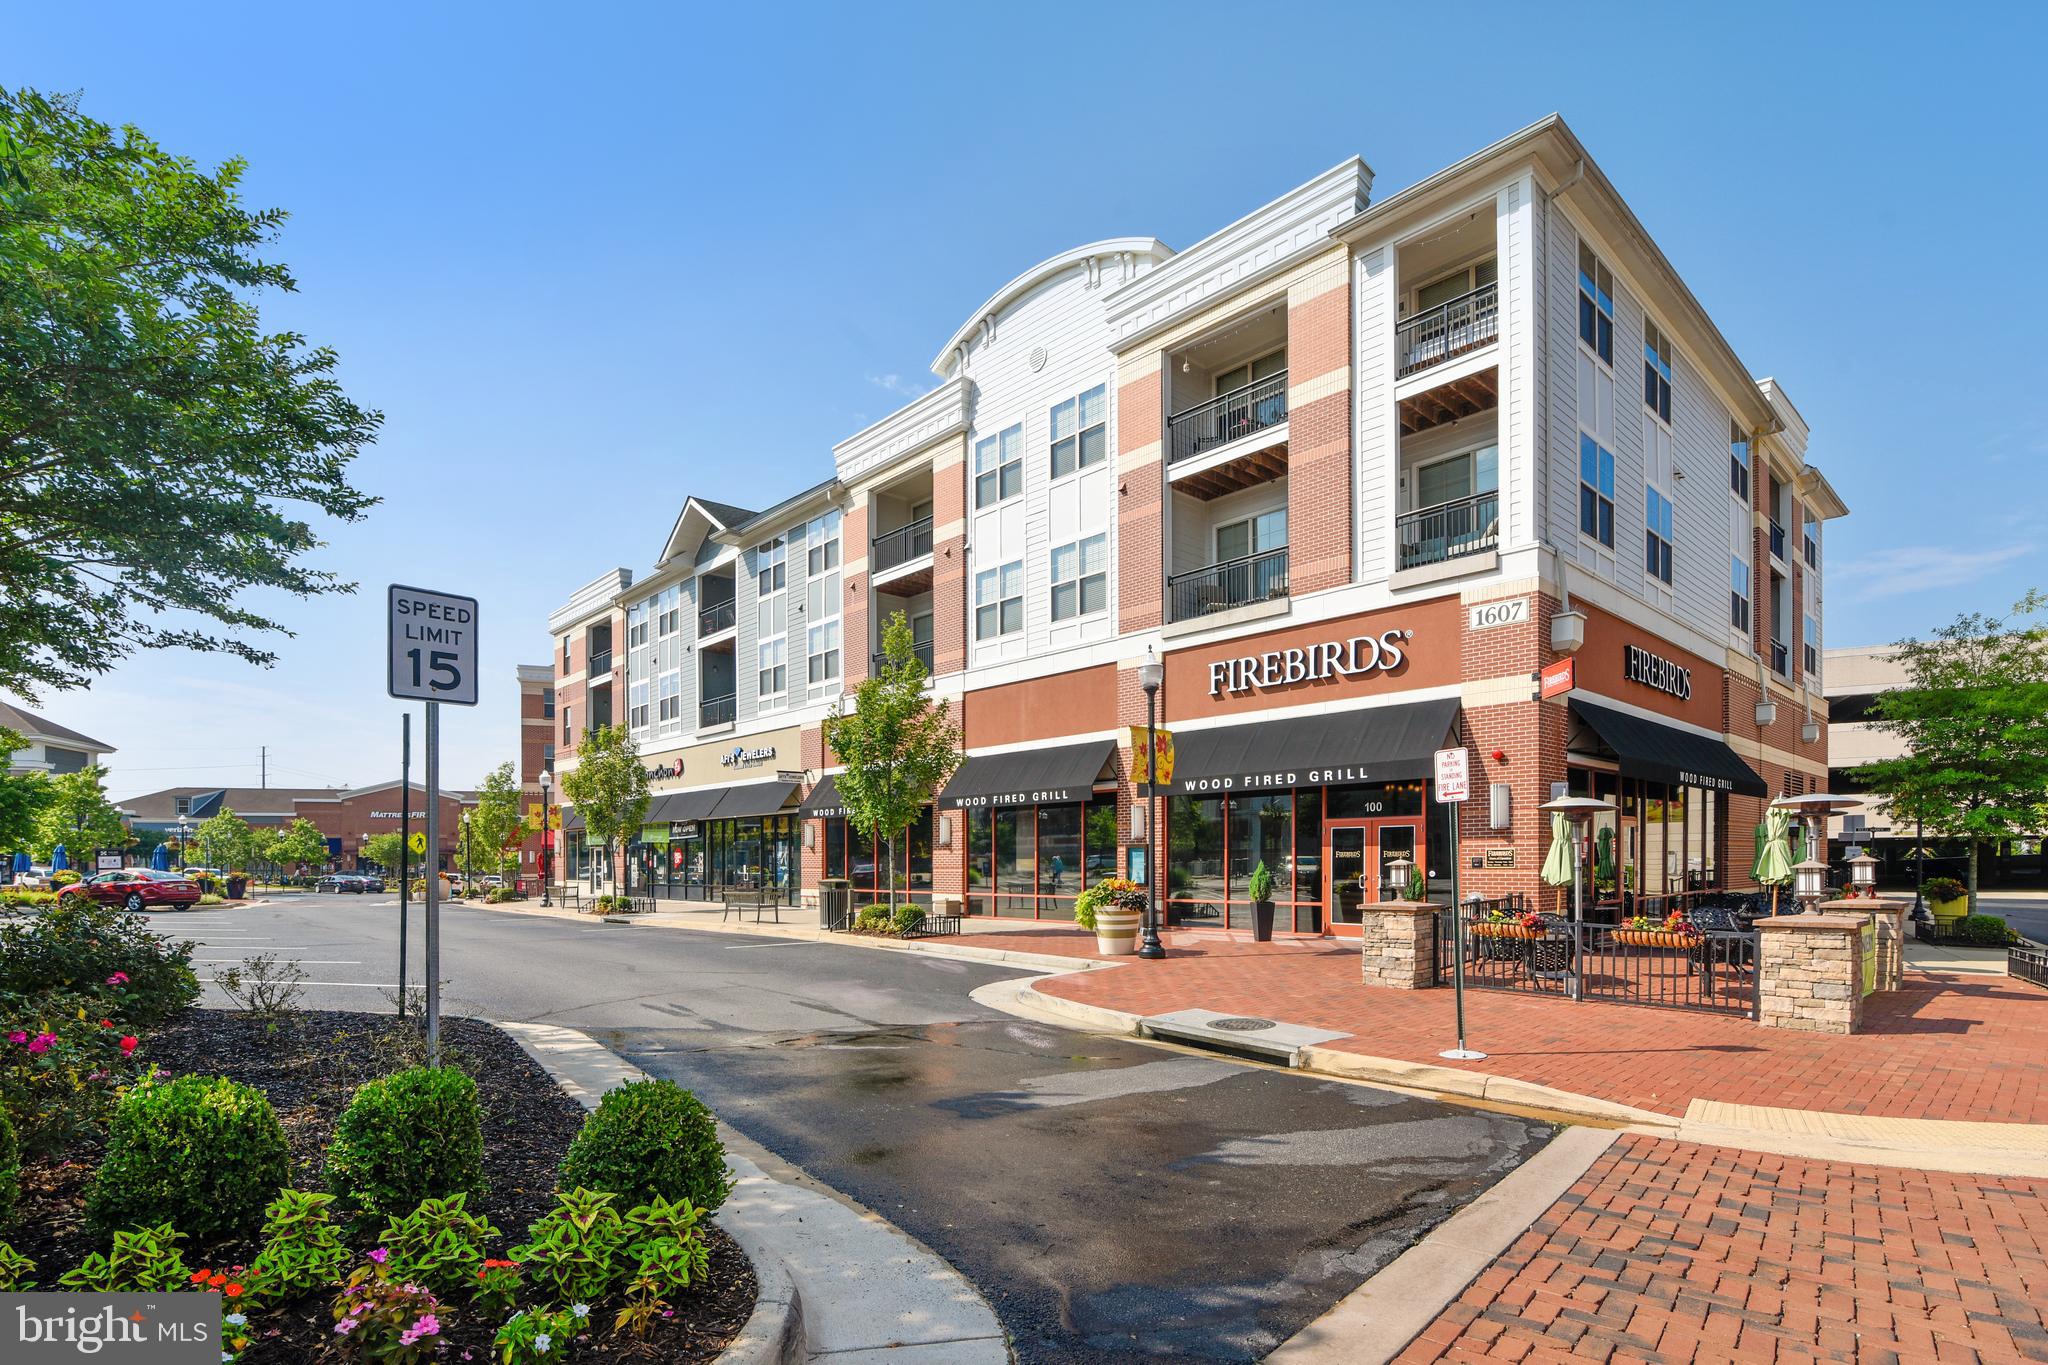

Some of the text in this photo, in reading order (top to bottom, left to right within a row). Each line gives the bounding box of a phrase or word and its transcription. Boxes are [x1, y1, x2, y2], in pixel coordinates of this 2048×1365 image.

[397, 599, 471, 624] SPEED
[1475, 601, 1523, 627] 1607
[405, 623, 463, 646] LIMIT
[407, 648, 462, 691] 15
[1630, 644, 1692, 701] FIREBIRDS
[740, 746, 773, 761] JEWELERS
[1446, 752, 1456, 760] NO
[644, 764, 674, 780] onchon
[1441, 760, 1461, 768] PARKING
[1185, 767, 1369, 791] WOOD FIRED GRILL
[1438, 780, 1467, 792] FIRE LANE
[1679, 770, 1733, 791] WOOD FIRED GRILL
[956, 790, 1069, 807] WOOD FIRED GRILL
[1364, 801, 1383, 812] 100
[812, 807, 856, 817] WOOD FIRE
